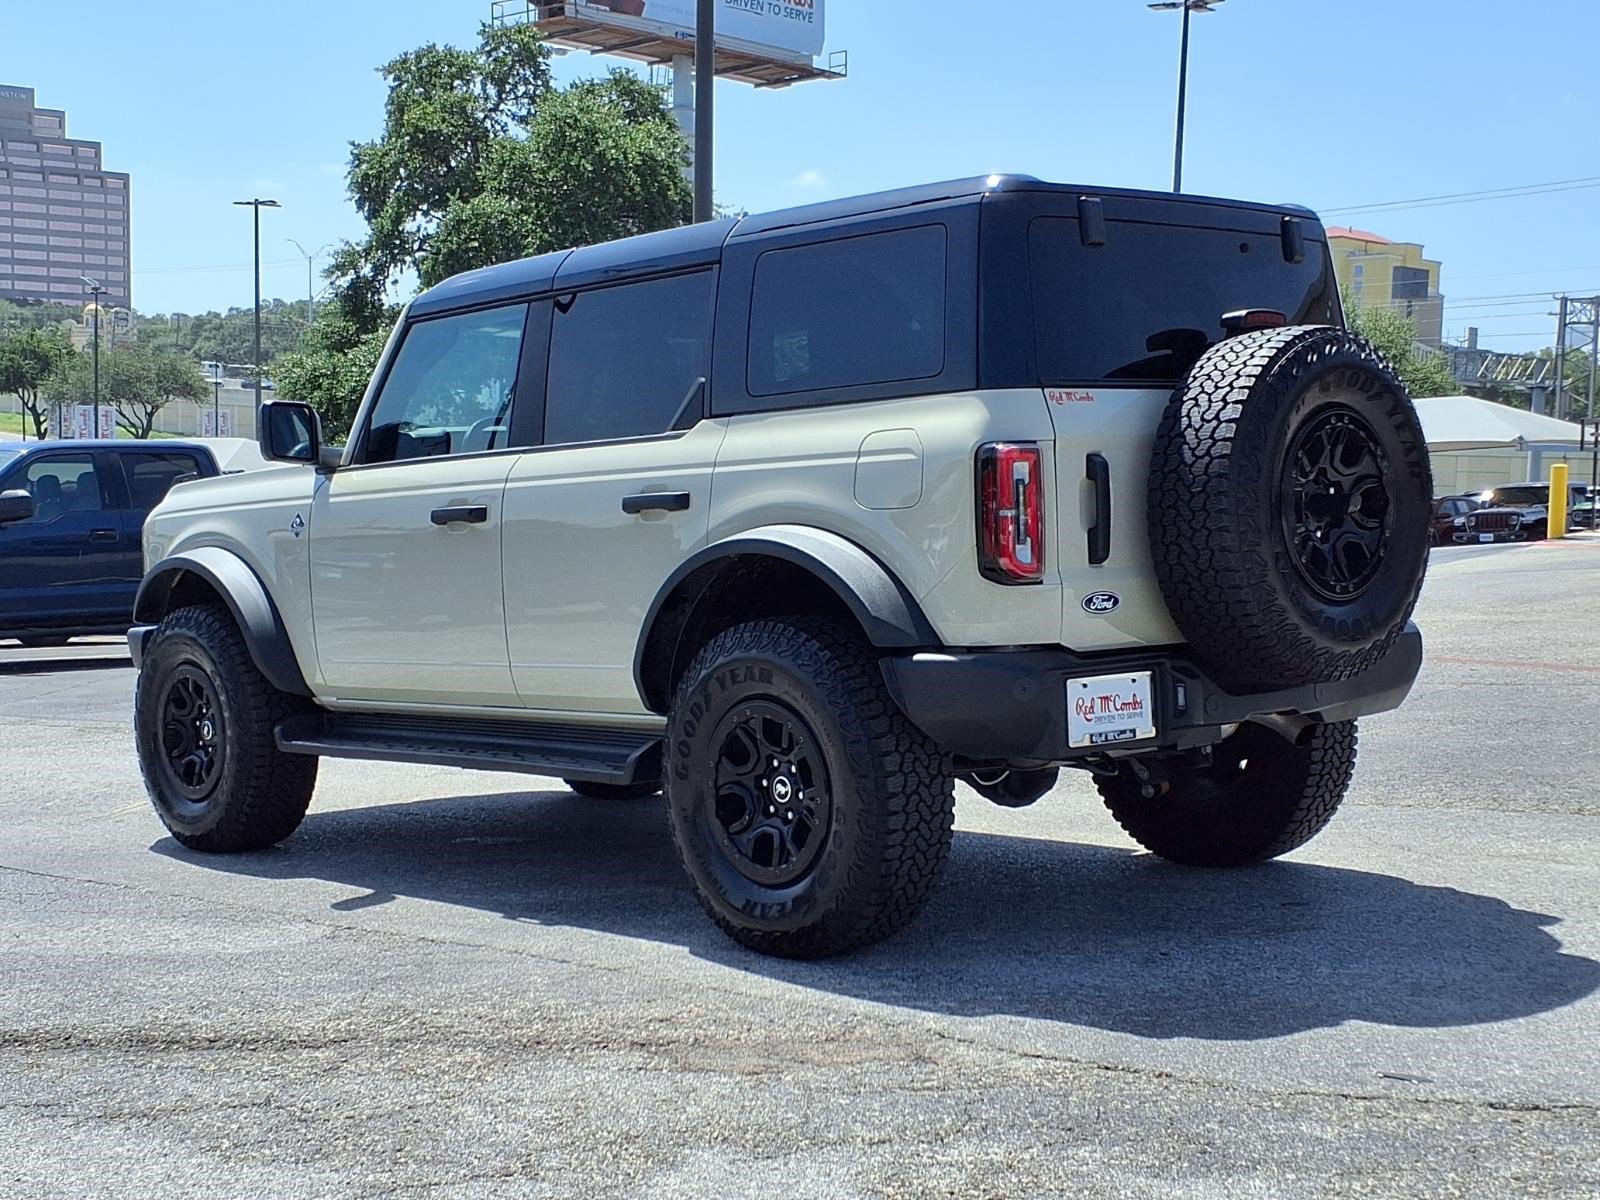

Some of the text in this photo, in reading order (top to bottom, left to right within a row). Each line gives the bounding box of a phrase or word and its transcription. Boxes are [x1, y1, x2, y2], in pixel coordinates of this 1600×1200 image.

[767, 2, 781, 16] TO
[783, 6, 814, 24] SERVE
[1049, 391, 1064, 405] Red
[1090, 595, 1114, 609] Ford
[1076, 693, 1143, 722] Red McCombs
[1094, 714, 1116, 722] DRIVEN
[1126, 711, 1144, 719] SERVE
